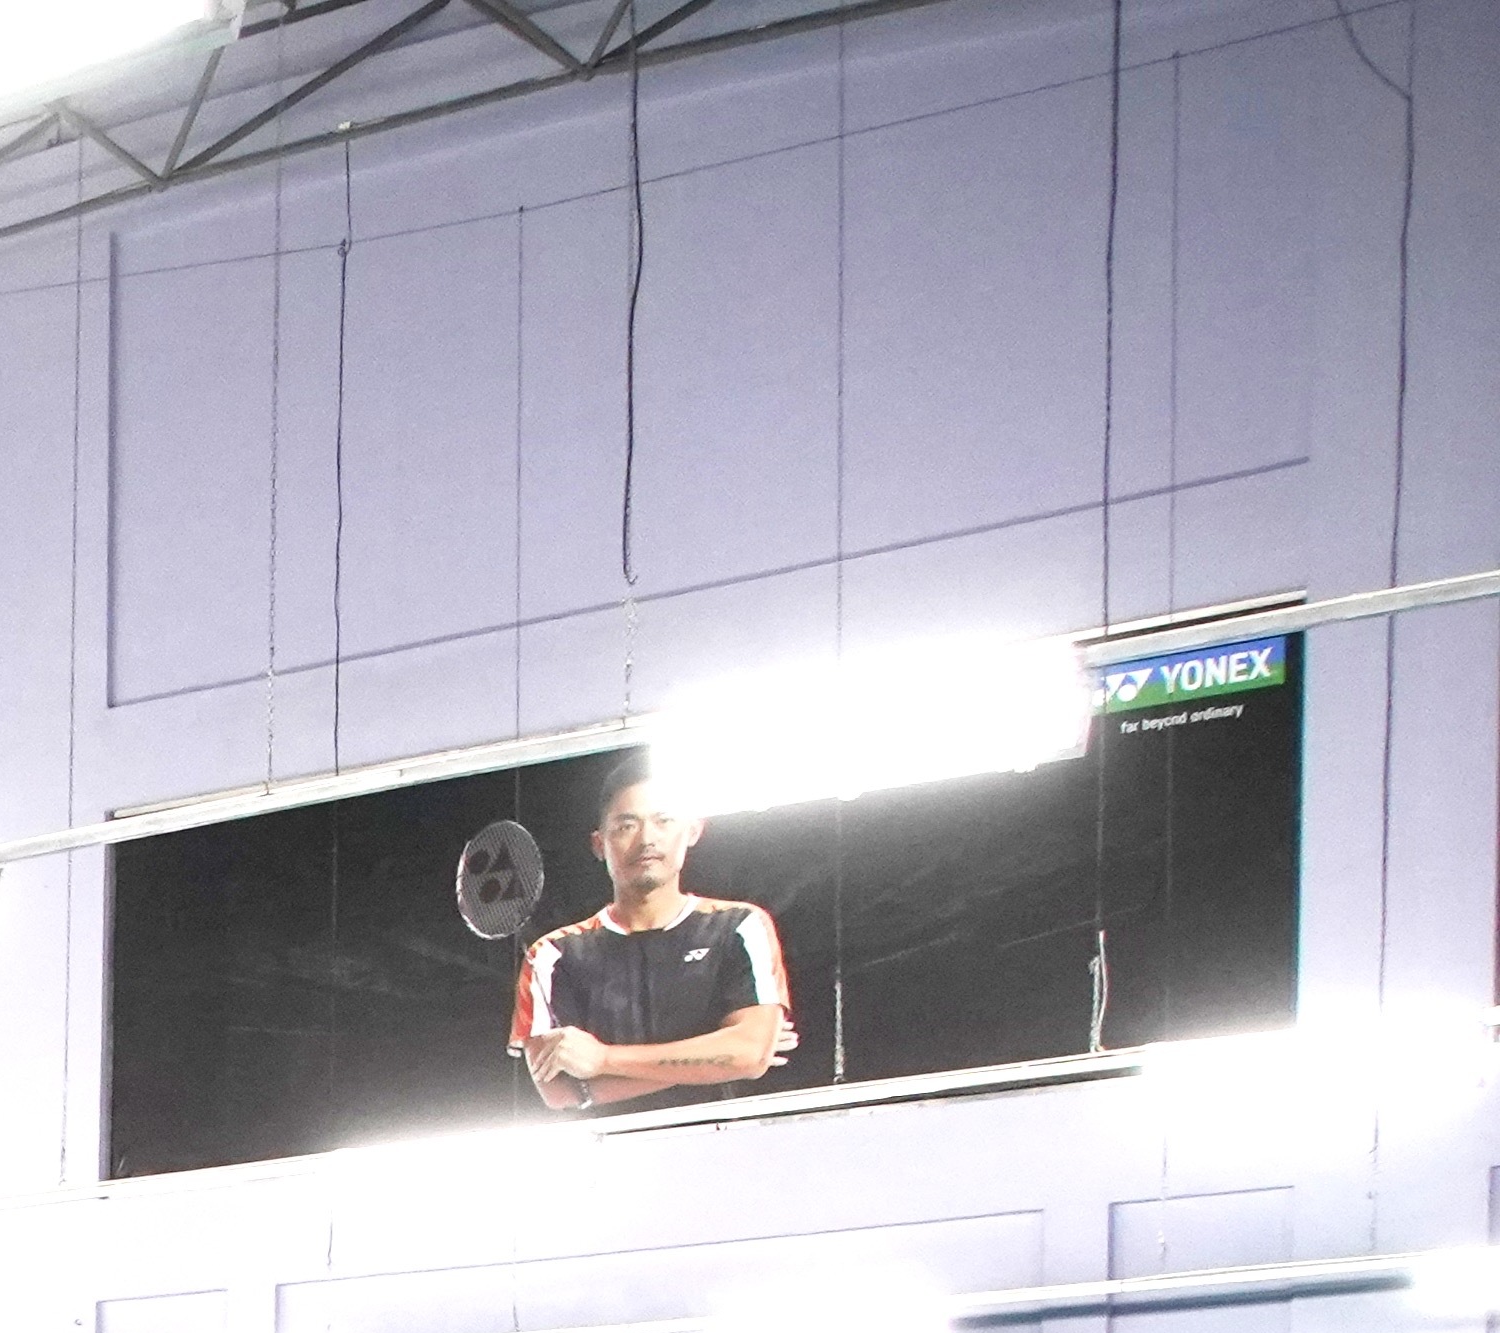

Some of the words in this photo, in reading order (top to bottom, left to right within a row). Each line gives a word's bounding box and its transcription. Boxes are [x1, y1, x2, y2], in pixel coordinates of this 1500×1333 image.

[1160, 646, 1273, 694] YONEX
[1120, 720, 1139, 735] far
[1142, 711, 1188, 732] beyond
[1190, 702, 1245, 724] ordinary
